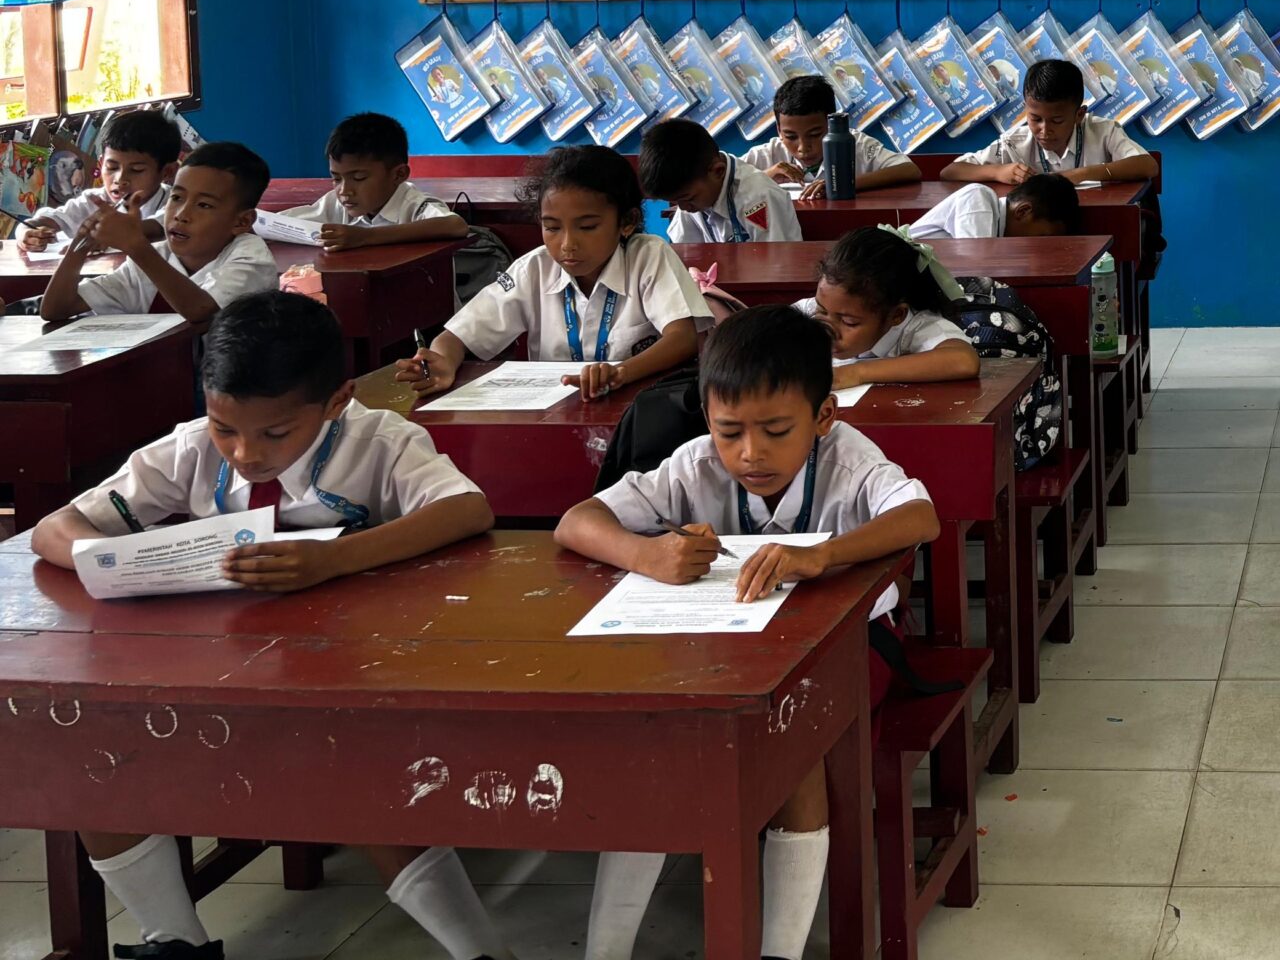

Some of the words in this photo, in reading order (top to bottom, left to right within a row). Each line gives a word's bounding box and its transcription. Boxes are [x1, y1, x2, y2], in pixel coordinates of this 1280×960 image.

[137, 543, 173, 555] PEMERINTAH
[176, 540, 192, 548] KOTA
[194, 534, 218, 544] SORONG
